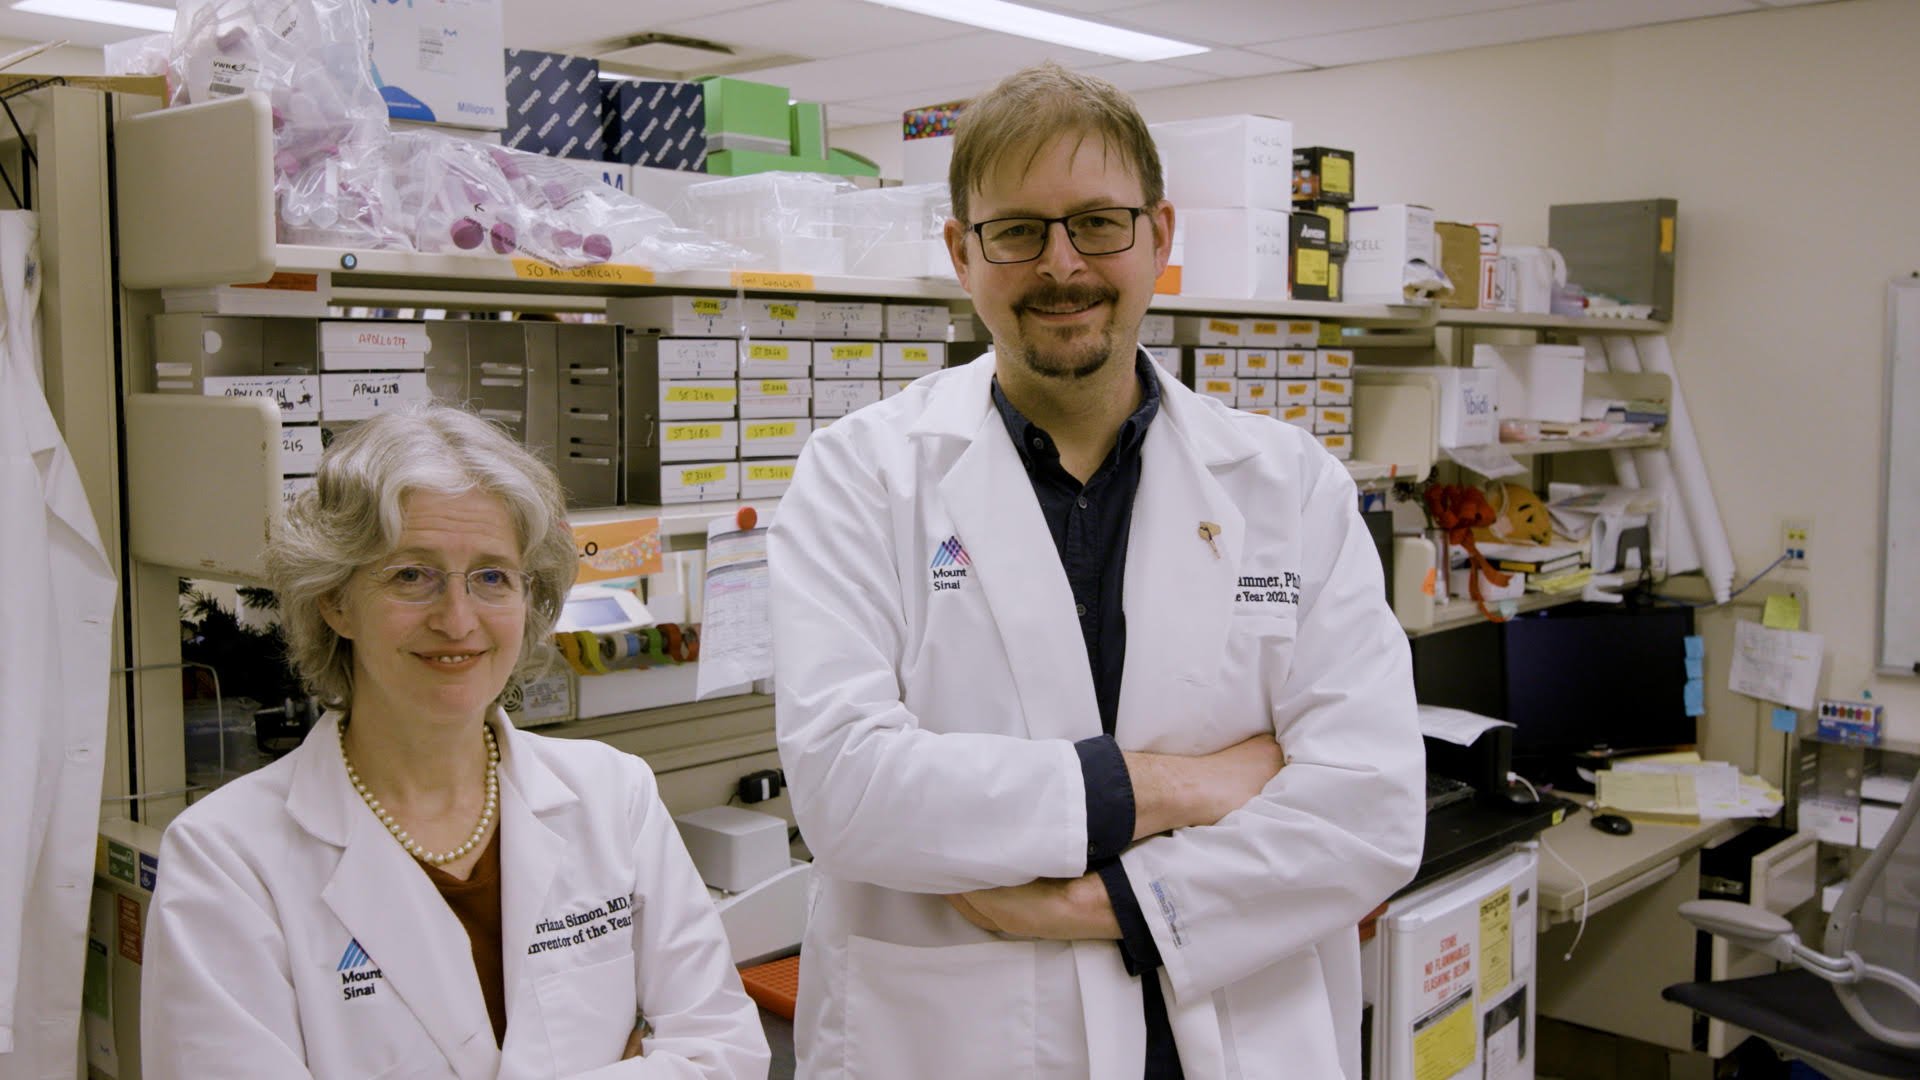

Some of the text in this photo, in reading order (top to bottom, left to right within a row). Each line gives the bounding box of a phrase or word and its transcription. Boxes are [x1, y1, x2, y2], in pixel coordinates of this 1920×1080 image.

[526, 263, 544, 278] 50
[283, 440, 304, 452] 215
[933, 568, 967, 579] Mount
[933, 580, 961, 591] Sinai
[1242, 591, 1264, 602] Year
[1265, 591, 1290, 603] 2021,
[565, 907, 607, 928] Simon,
[573, 929, 585, 945] of
[586, 923, 608, 940] the
[607, 916, 632, 931] Year
[342, 968, 383, 985] Mount
[343, 983, 376, 1001] Sinai
